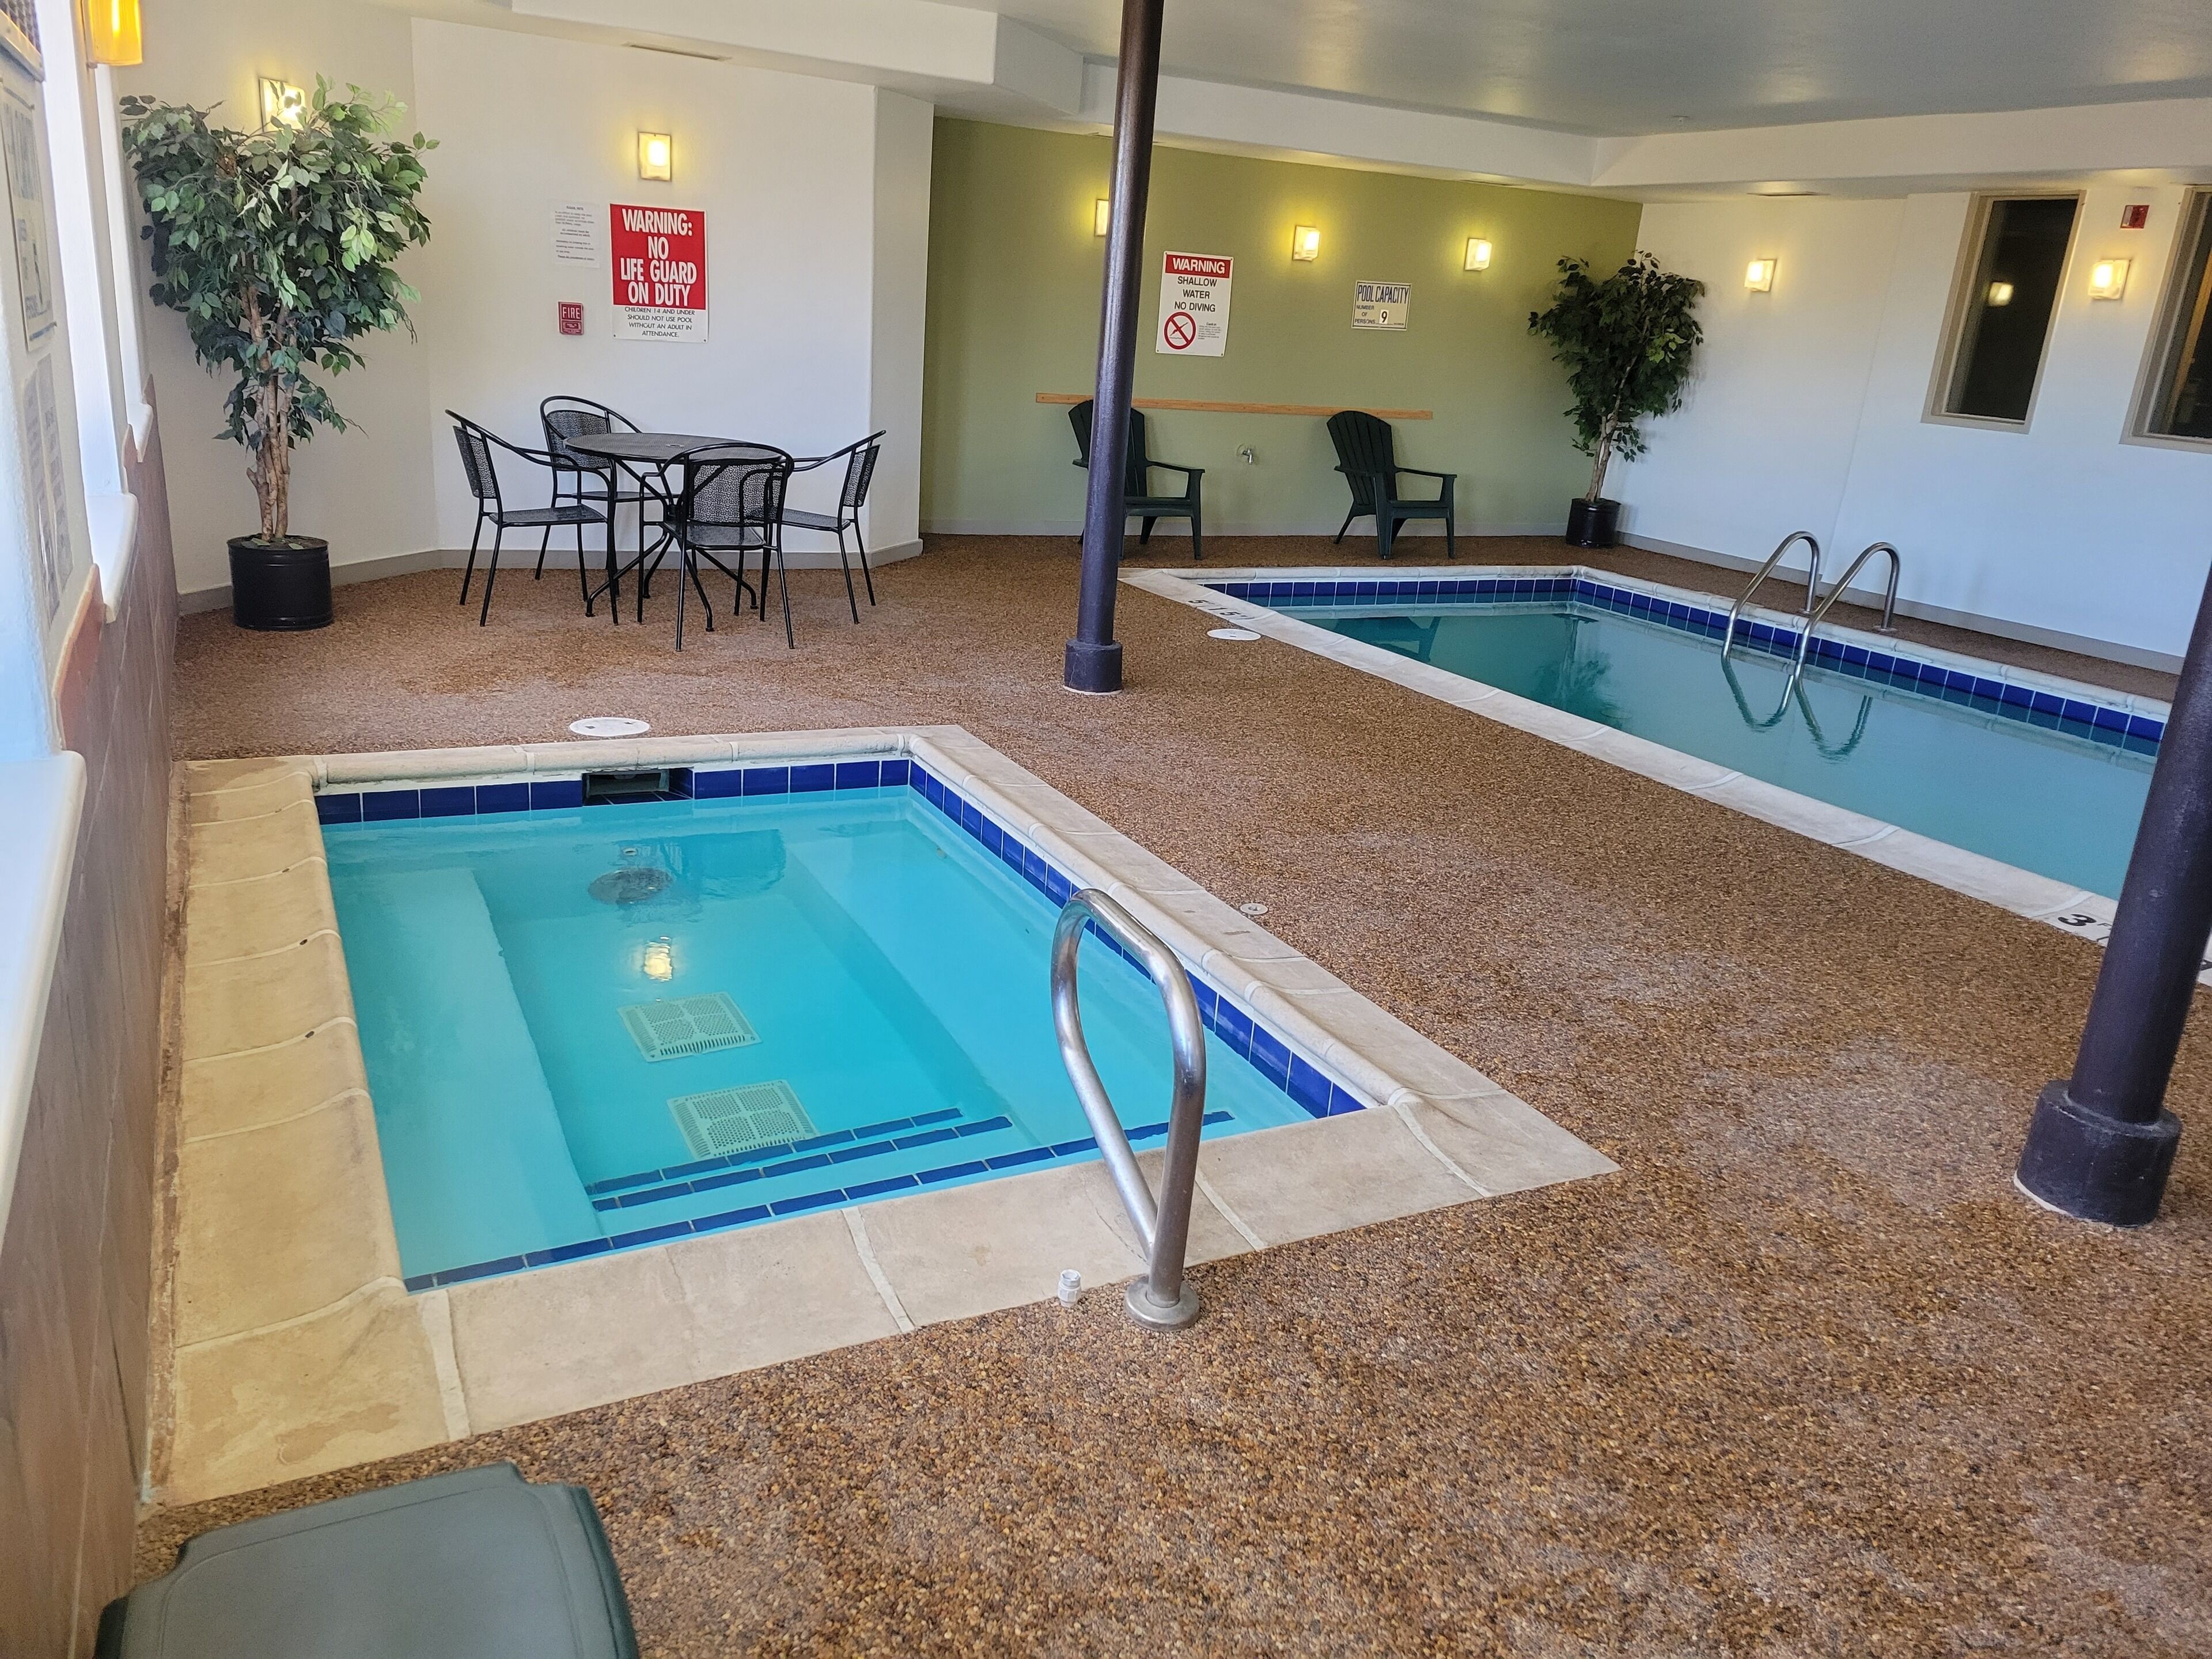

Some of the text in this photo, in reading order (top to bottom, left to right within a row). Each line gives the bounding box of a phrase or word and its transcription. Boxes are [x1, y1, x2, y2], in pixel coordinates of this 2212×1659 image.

[622, 208, 692, 236] WARNING:
[647, 236, 669, 260] NO
[620, 257, 697, 284] LIFE GUARD
[1173, 257, 1225, 274] WARNING
[1177, 276, 1217, 287] SHALLOW
[628, 281, 691, 306] ON DUTY
[1183, 289, 1210, 299] WATER
[1357, 285, 1409, 304] POOL CAPACITY
[562, 306, 581, 319] FIRE
[1174, 301, 1215, 312] NO DIVING
[1381, 311, 1388, 323] 9
[2058, 914, 2097, 926] 3
